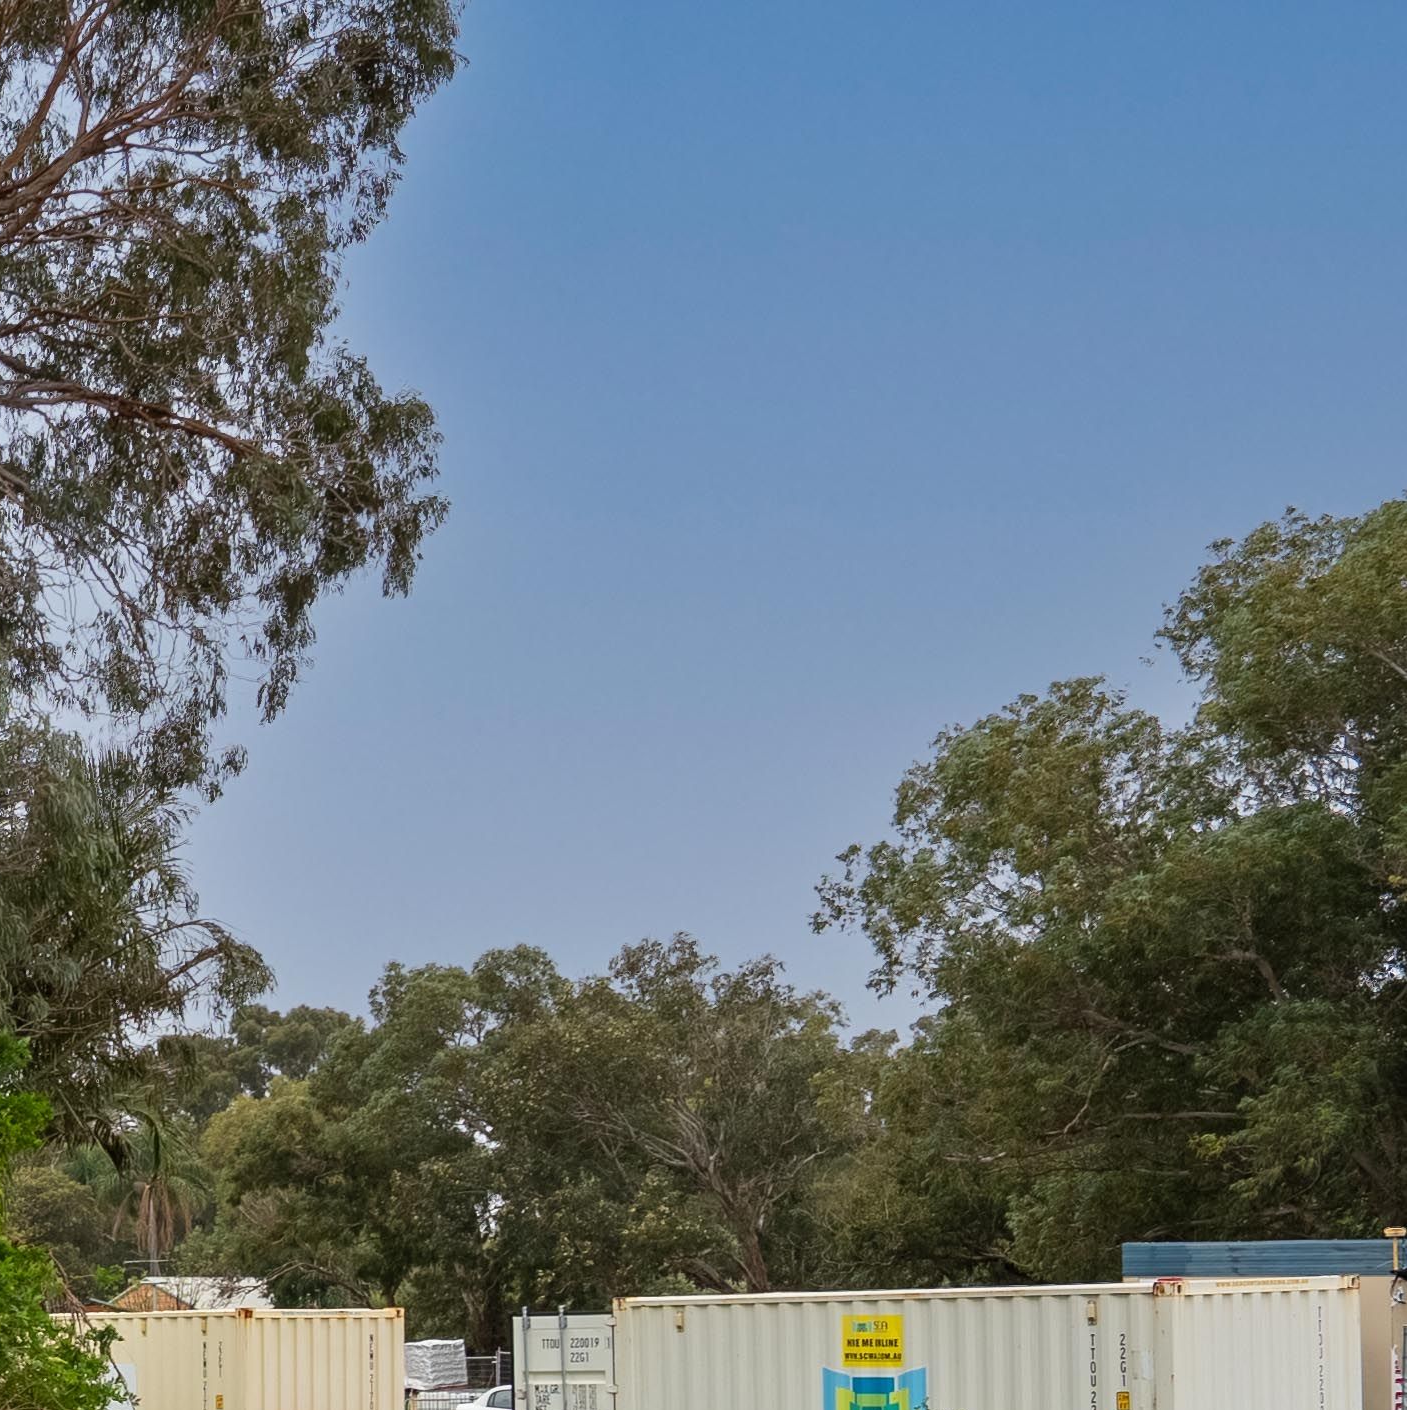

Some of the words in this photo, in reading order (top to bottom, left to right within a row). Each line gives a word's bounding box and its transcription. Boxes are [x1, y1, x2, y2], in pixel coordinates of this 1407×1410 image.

[542, 1338, 560, 1349] TTOU
[570, 1337, 600, 1348] 220019
[862, 1338, 873, 1348] ME
[570, 1352, 589, 1363] 22G1
[1119, 1333, 1127, 1387] 22G1
